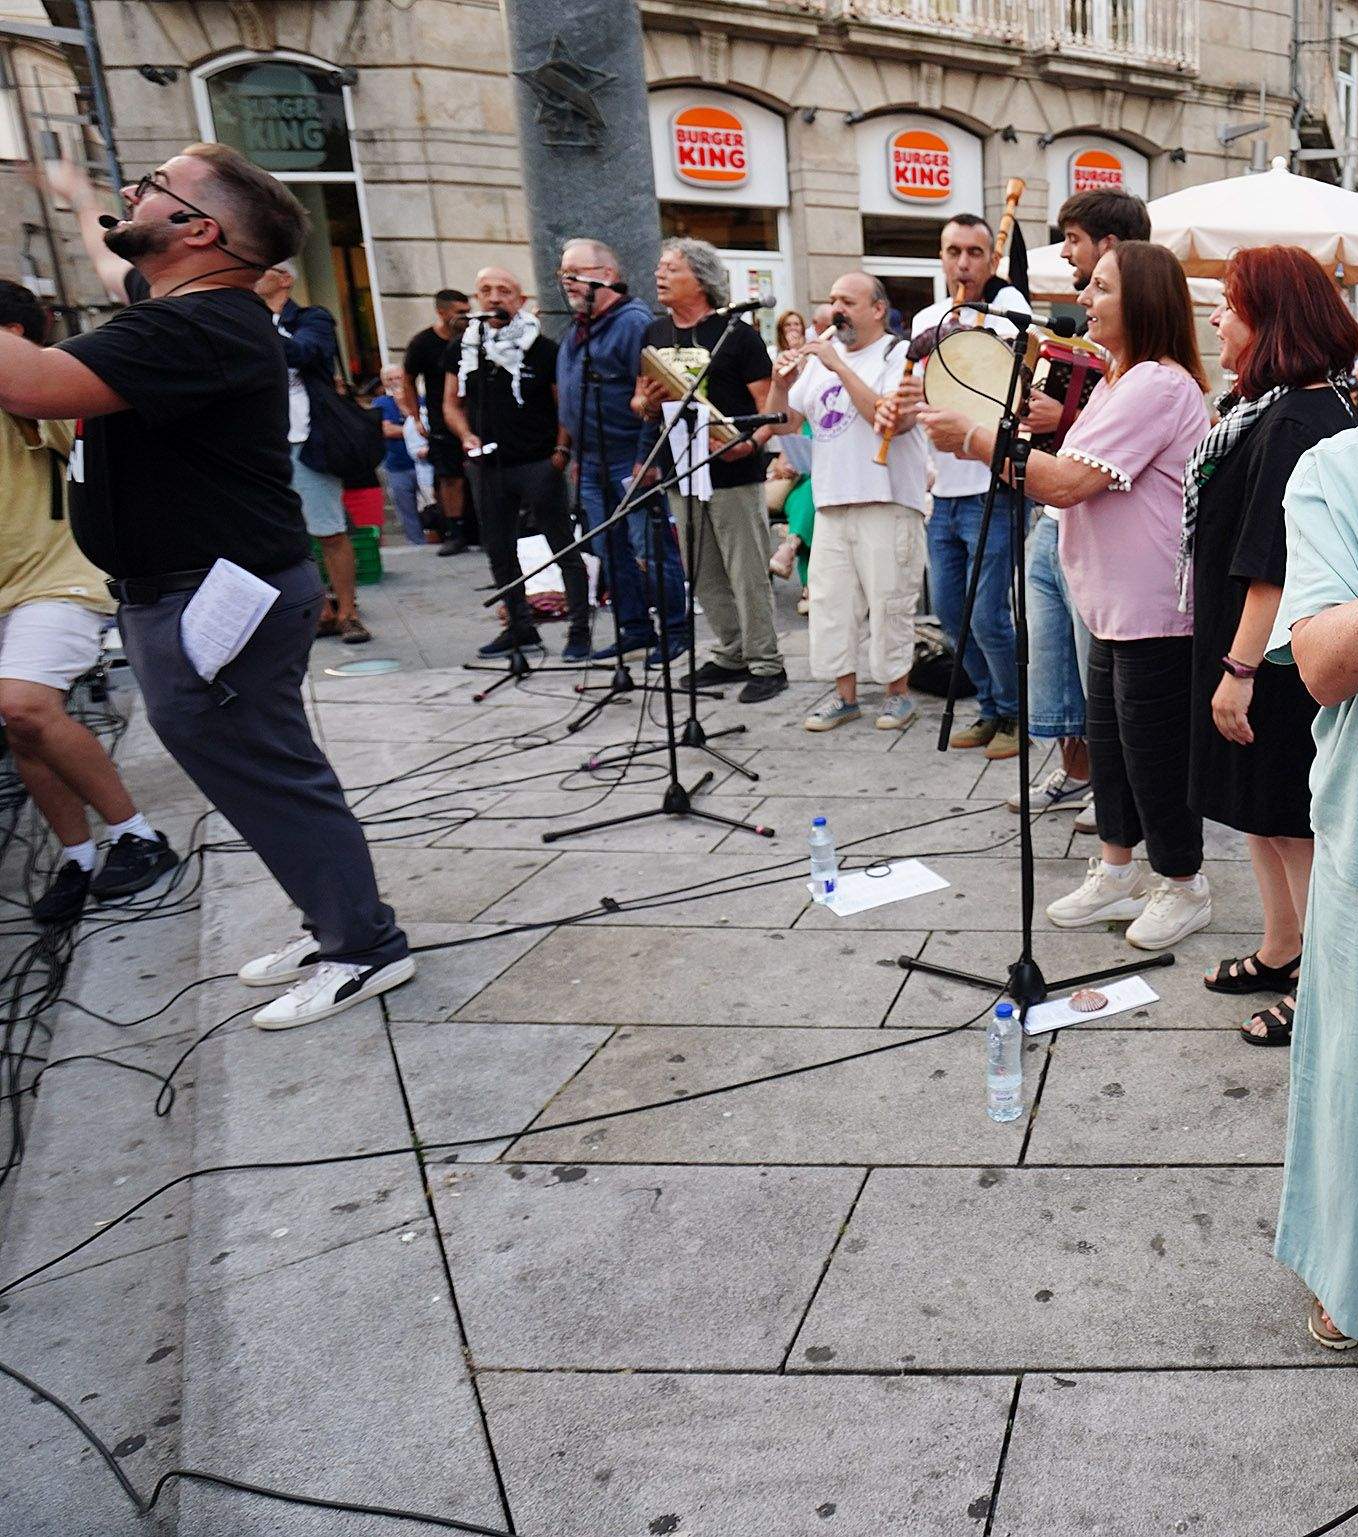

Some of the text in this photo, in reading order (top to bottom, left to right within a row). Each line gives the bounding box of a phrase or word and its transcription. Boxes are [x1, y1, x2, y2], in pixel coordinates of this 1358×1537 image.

[676, 129, 743, 146] BURGER
[679, 146, 745, 168] KING
[893, 151, 949, 166] BURGER
[895, 165, 949, 187] KING
[1075, 169, 1121, 183] BURGER
